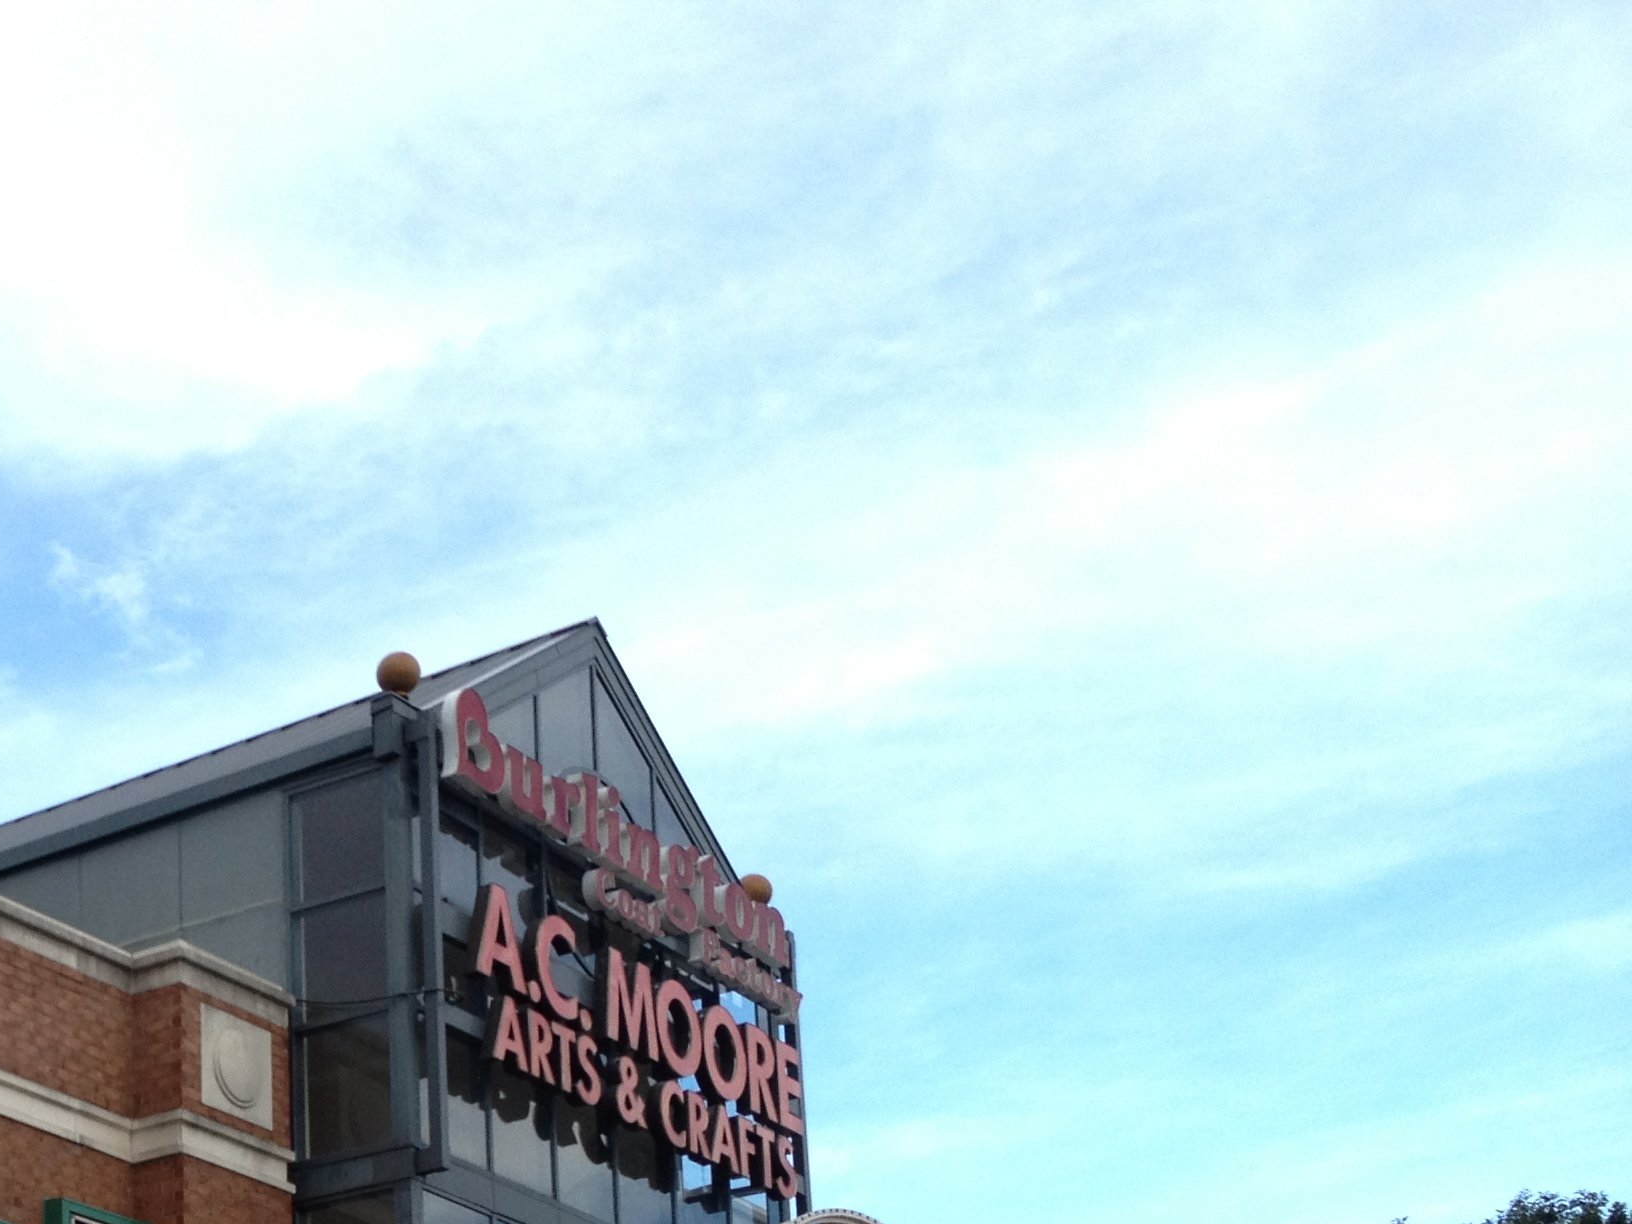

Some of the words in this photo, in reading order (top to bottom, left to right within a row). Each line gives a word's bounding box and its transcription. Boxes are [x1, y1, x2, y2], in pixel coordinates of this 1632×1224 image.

[443, 688, 789, 970] Burlington
[475, 883, 593, 1032] A.C.
[607, 946, 804, 1136] MOORE
[494, 996, 602, 1106] ARTS
[616, 1056, 646, 1129] &
[660, 1084, 798, 1200] CRAFTS
